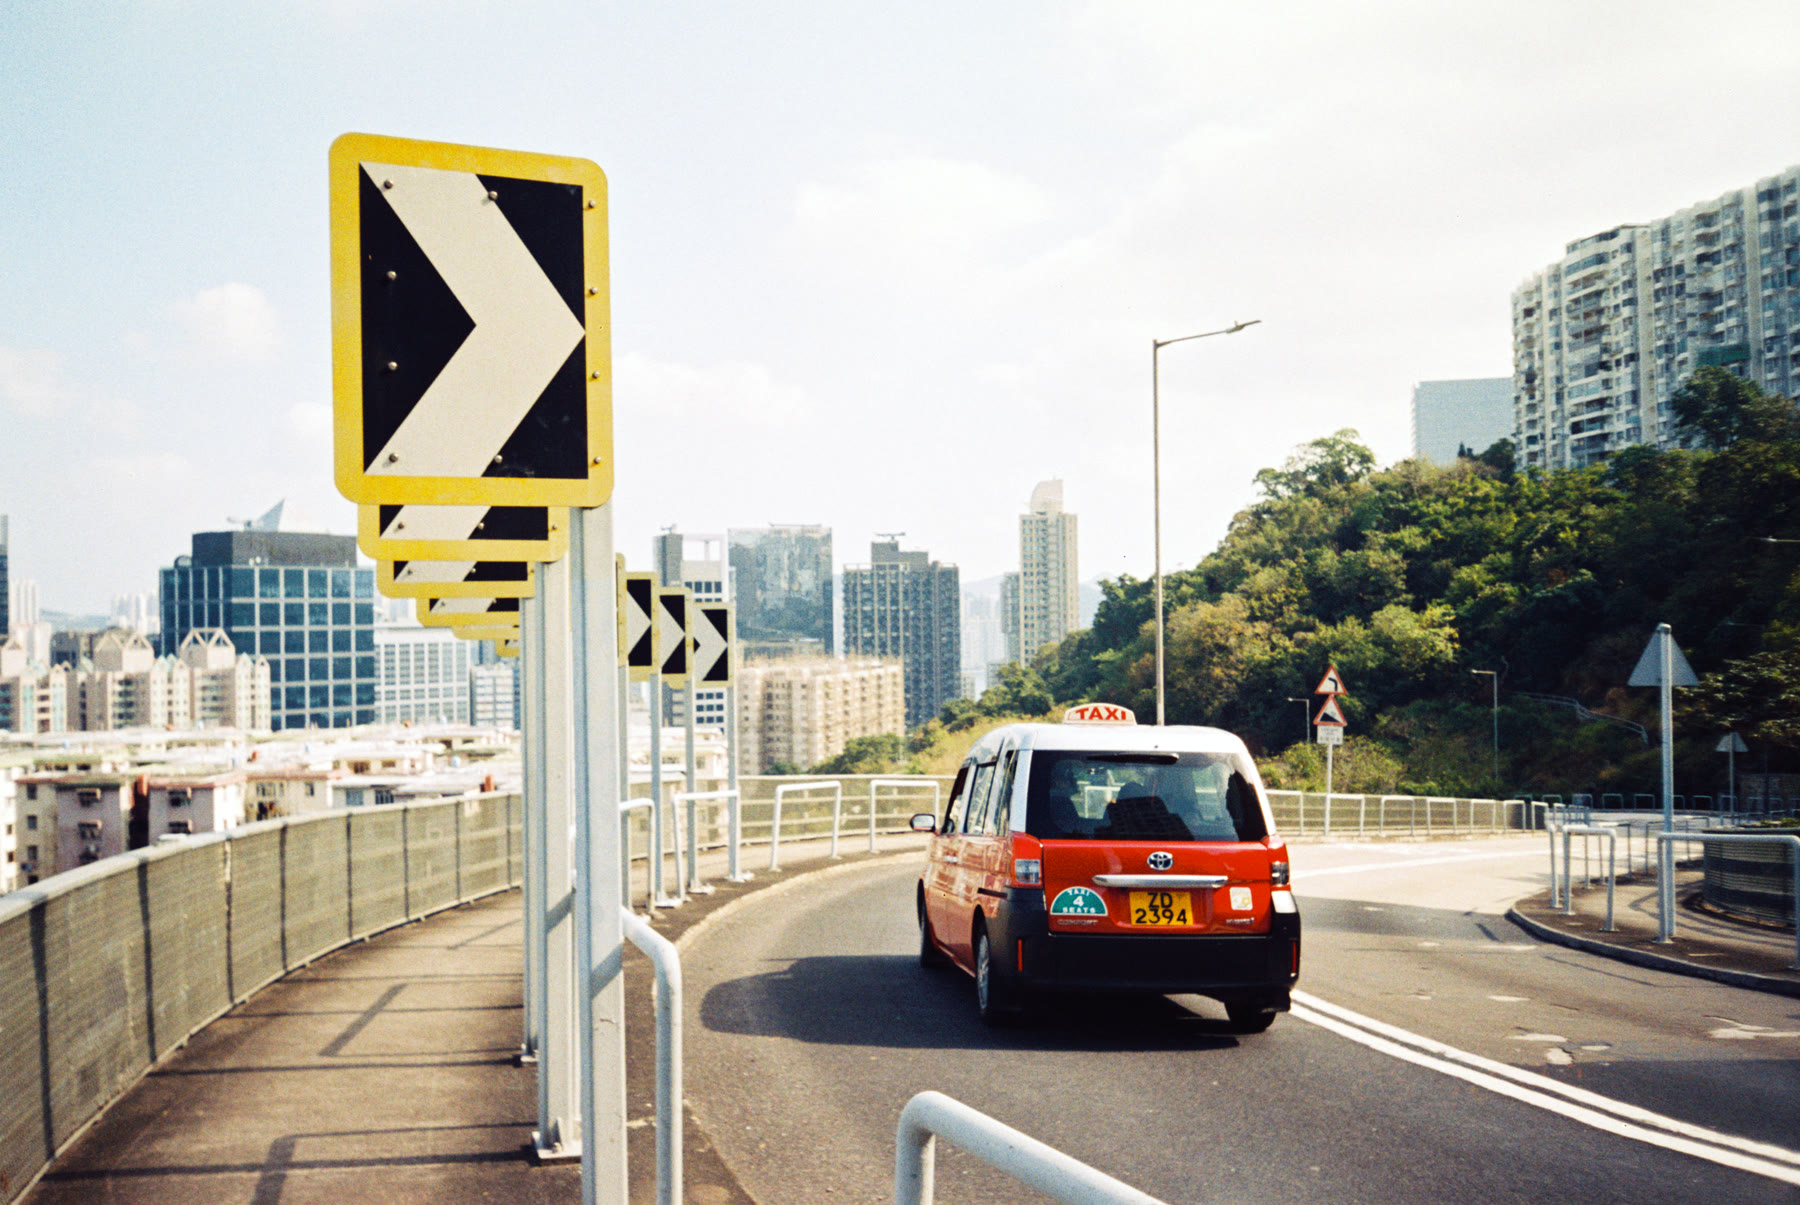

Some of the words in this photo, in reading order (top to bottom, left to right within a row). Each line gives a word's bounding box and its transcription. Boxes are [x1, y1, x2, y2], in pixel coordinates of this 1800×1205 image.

[1075, 706, 1126, 720] TAXI
[1067, 888, 1090, 896] TAXI
[1073, 895, 1084, 906] 4
[1147, 892, 1173, 908] ZD
[1135, 908, 1187, 924] 2394
